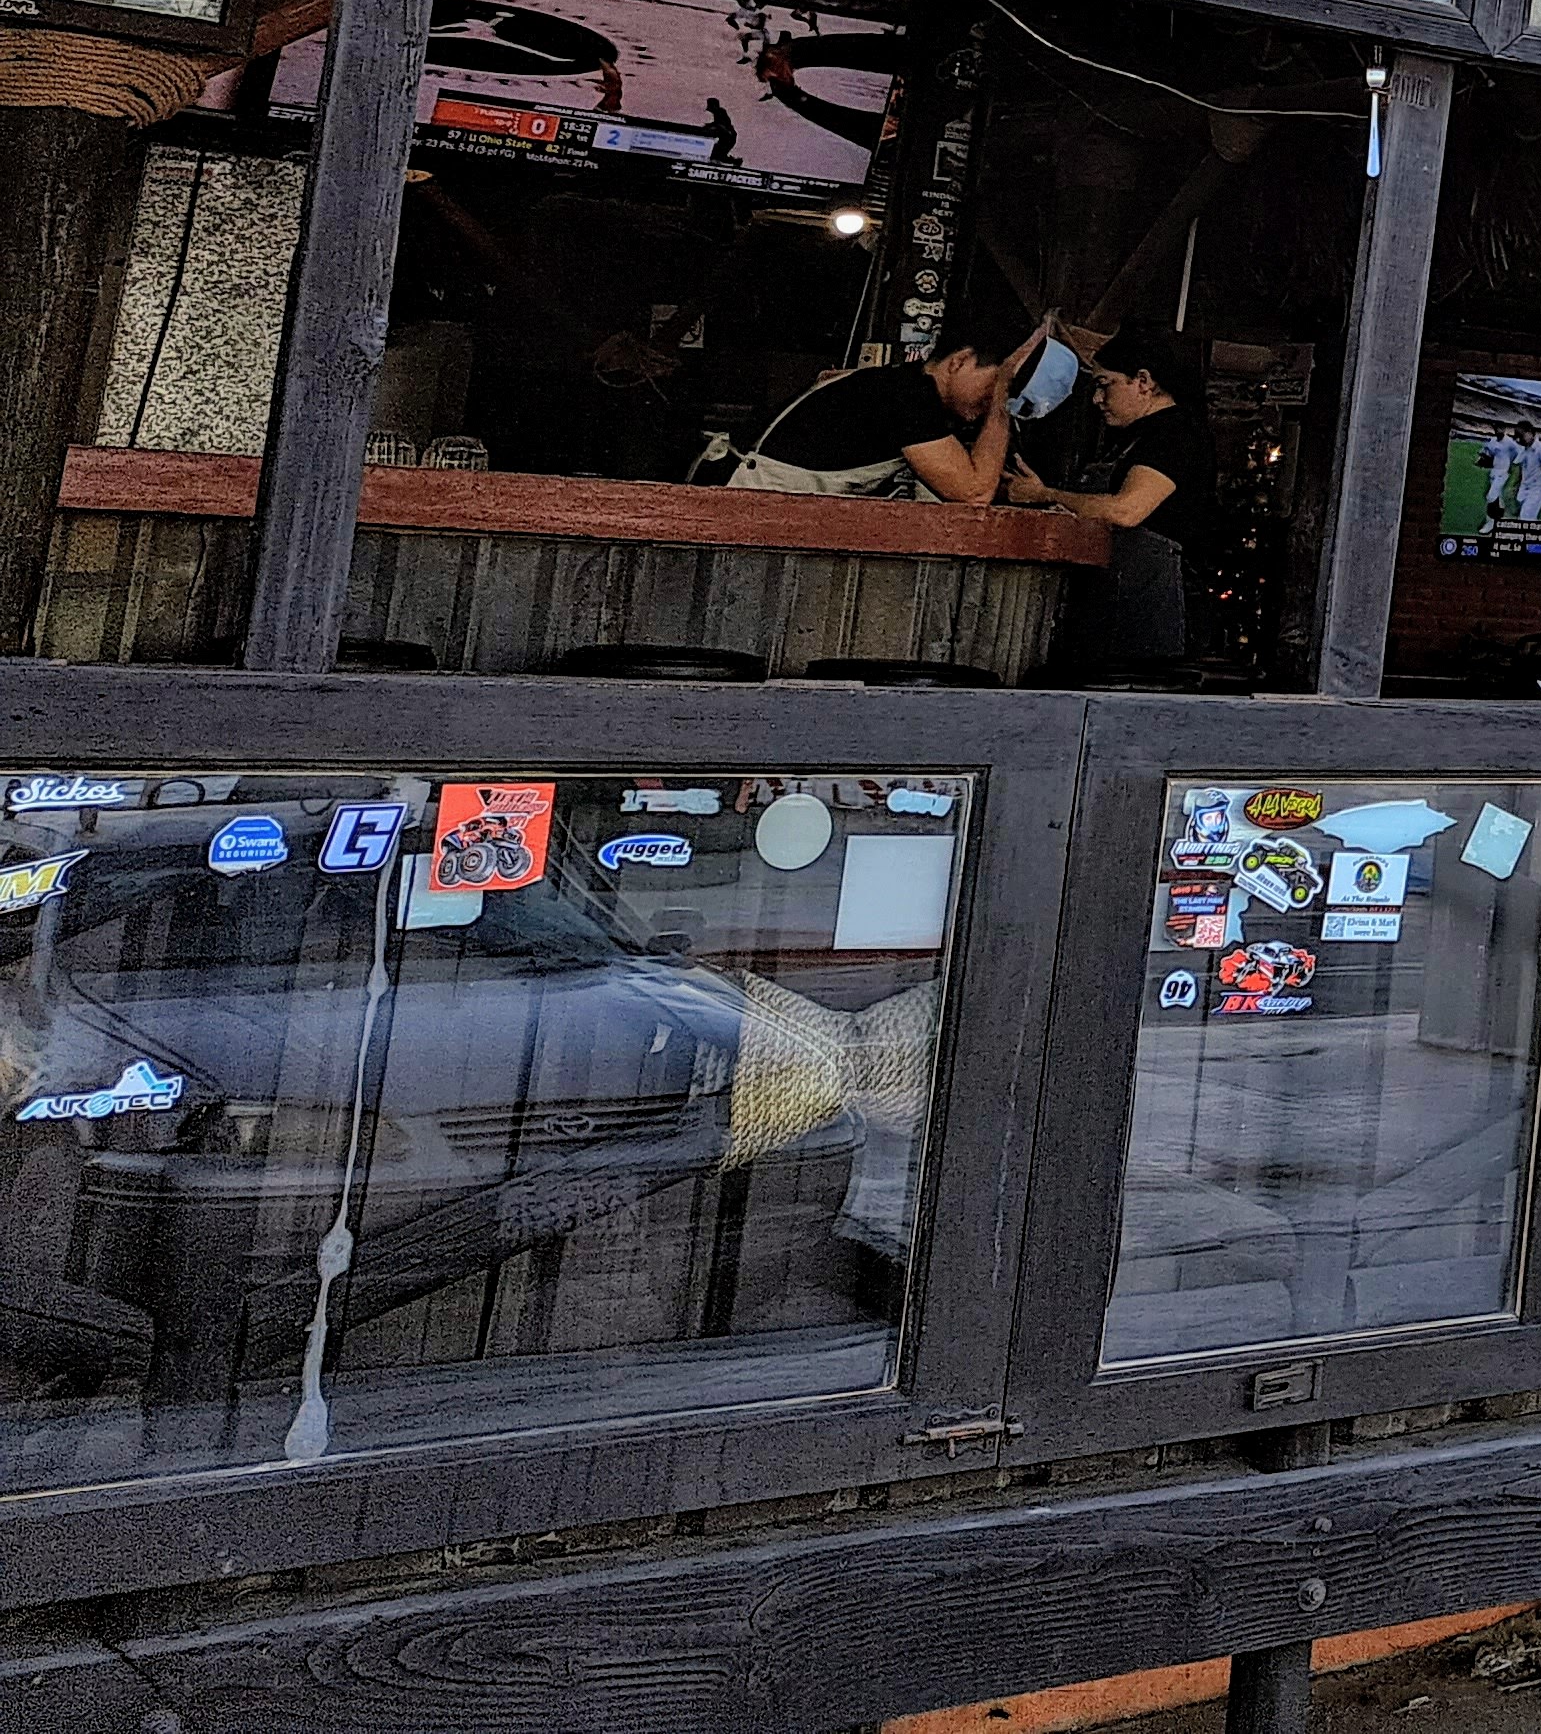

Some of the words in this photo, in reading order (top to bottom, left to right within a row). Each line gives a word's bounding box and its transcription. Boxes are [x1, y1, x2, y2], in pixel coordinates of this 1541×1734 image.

[531, 118, 547, 135] 0
[479, 134, 502, 146] Ohio
[504, 137, 533, 150] State
[606, 129, 621, 146] 2
[688, 168, 719, 181] SAINTS
[725, 173, 763, 187] PACKERS
[10, 776, 126, 806] Sickos
[237, 834, 281, 848] Swann
[218, 849, 281, 860] SEGURIDAD
[1188, 897, 1207, 906] LAST
[1379, 917, 1397, 927] Mark
[1371, 928, 1389, 938] here
[1220, 995, 1260, 1012] BK
